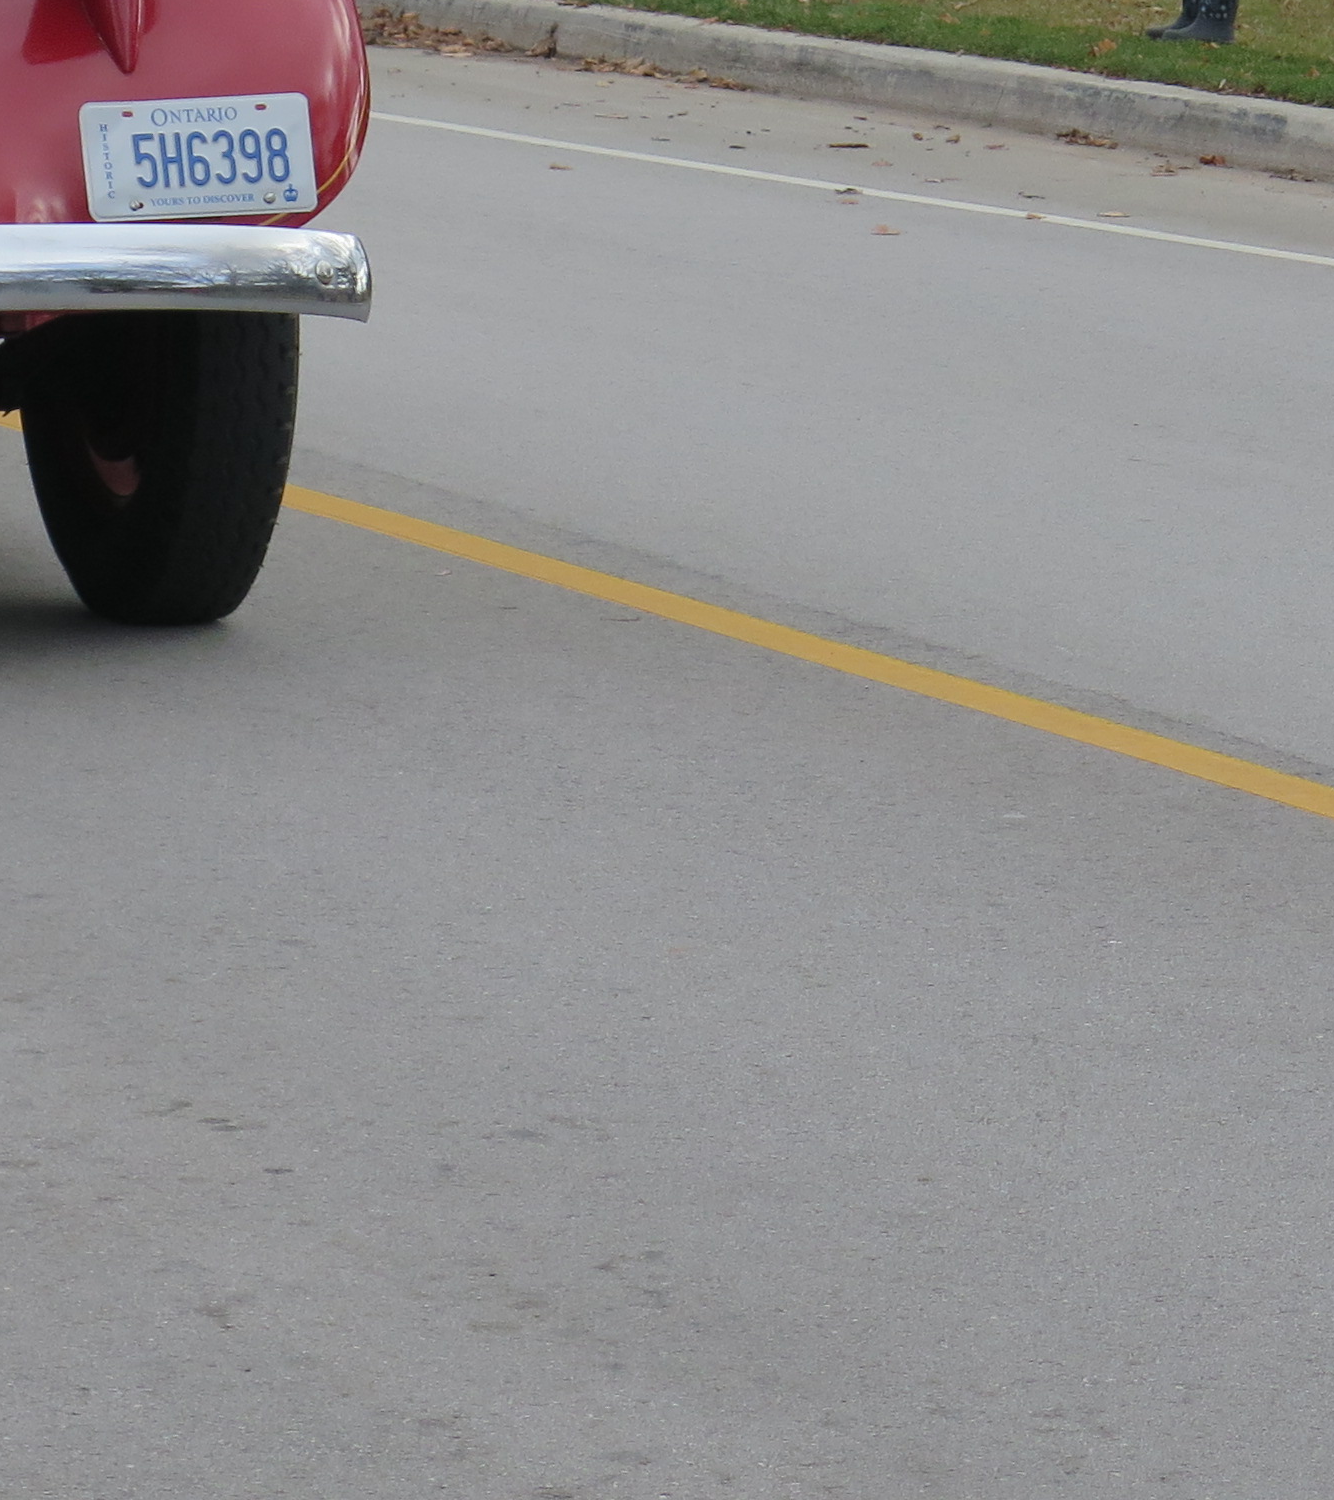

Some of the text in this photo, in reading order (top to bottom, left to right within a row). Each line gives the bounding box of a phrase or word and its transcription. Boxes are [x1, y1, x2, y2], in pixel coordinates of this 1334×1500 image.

[99, 123, 116, 199] HISTORIC
[131, 127, 291, 188] 5H6398
[151, 193, 255, 207] YOURS TO DISCOVER
